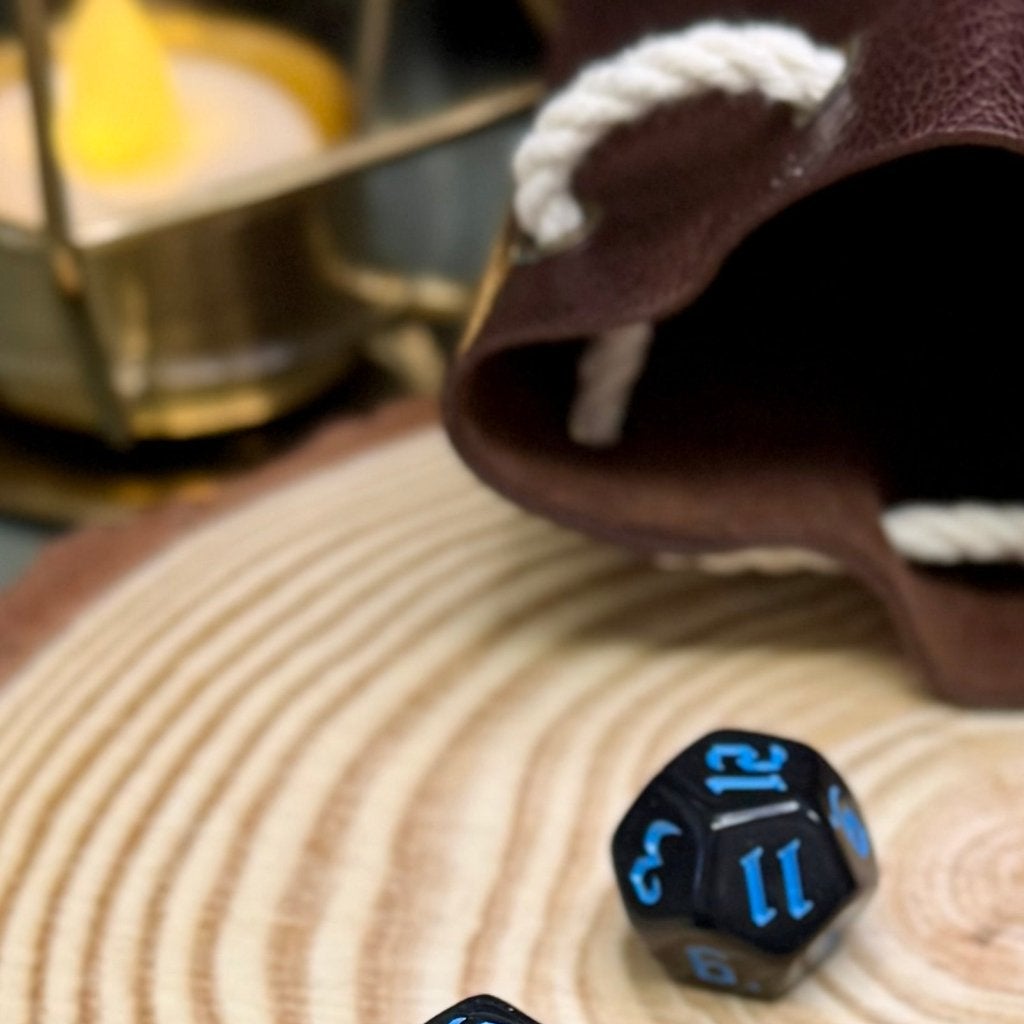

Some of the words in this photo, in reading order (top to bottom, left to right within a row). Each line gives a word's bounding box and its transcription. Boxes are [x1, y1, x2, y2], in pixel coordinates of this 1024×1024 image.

[705, 742, 789, 795] 12
[629, 819, 682, 906] 3
[739, 838, 814, 928] 11
